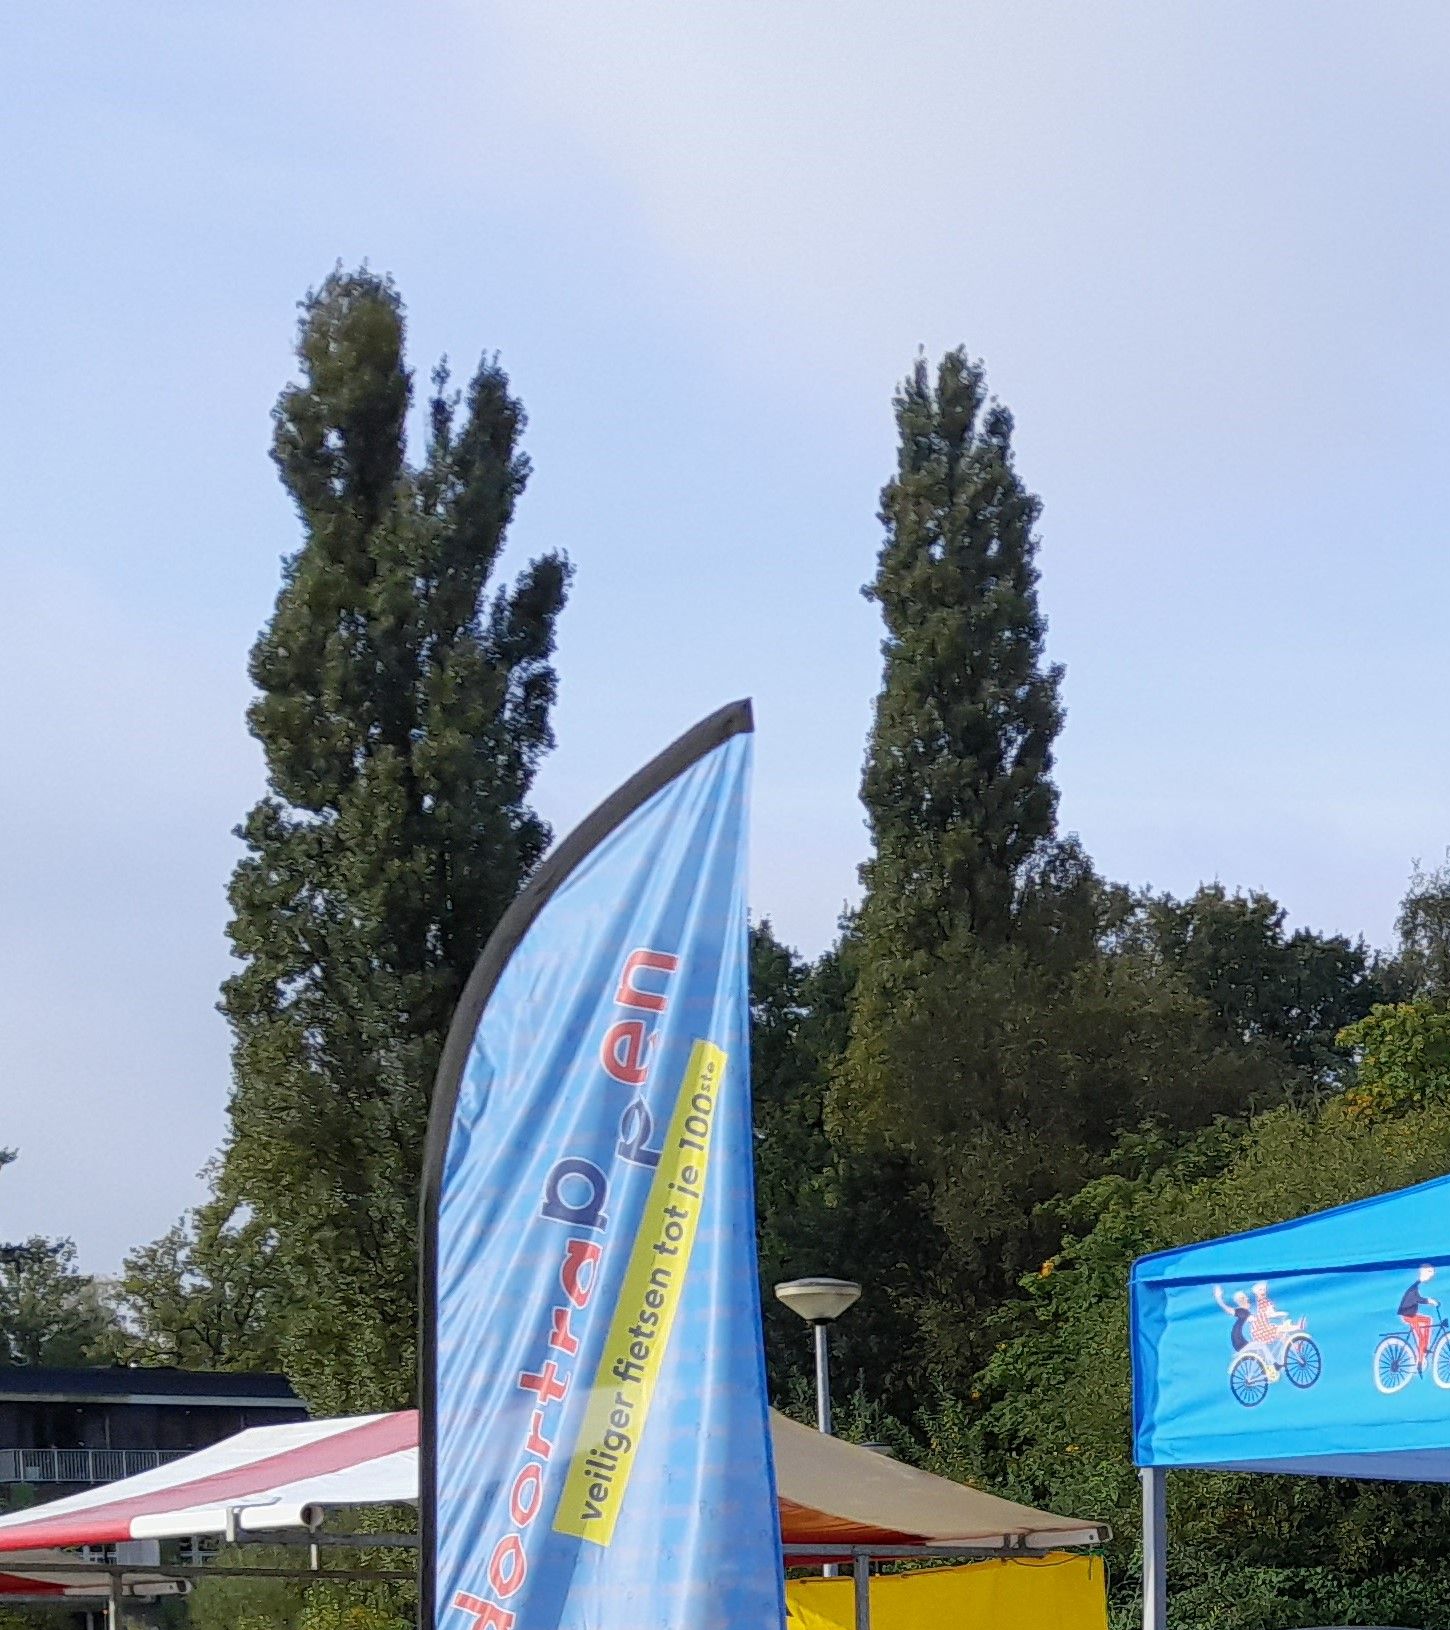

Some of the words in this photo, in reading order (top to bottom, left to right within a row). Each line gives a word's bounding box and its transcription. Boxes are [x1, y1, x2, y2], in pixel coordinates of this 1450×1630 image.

[678, 1060, 715, 1151] 100ste
[668, 1165, 700, 1199] je
[652, 1205, 689, 1256] tot
[612, 1267, 672, 1384] fietsen
[581, 1391, 634, 1520] veiliger
